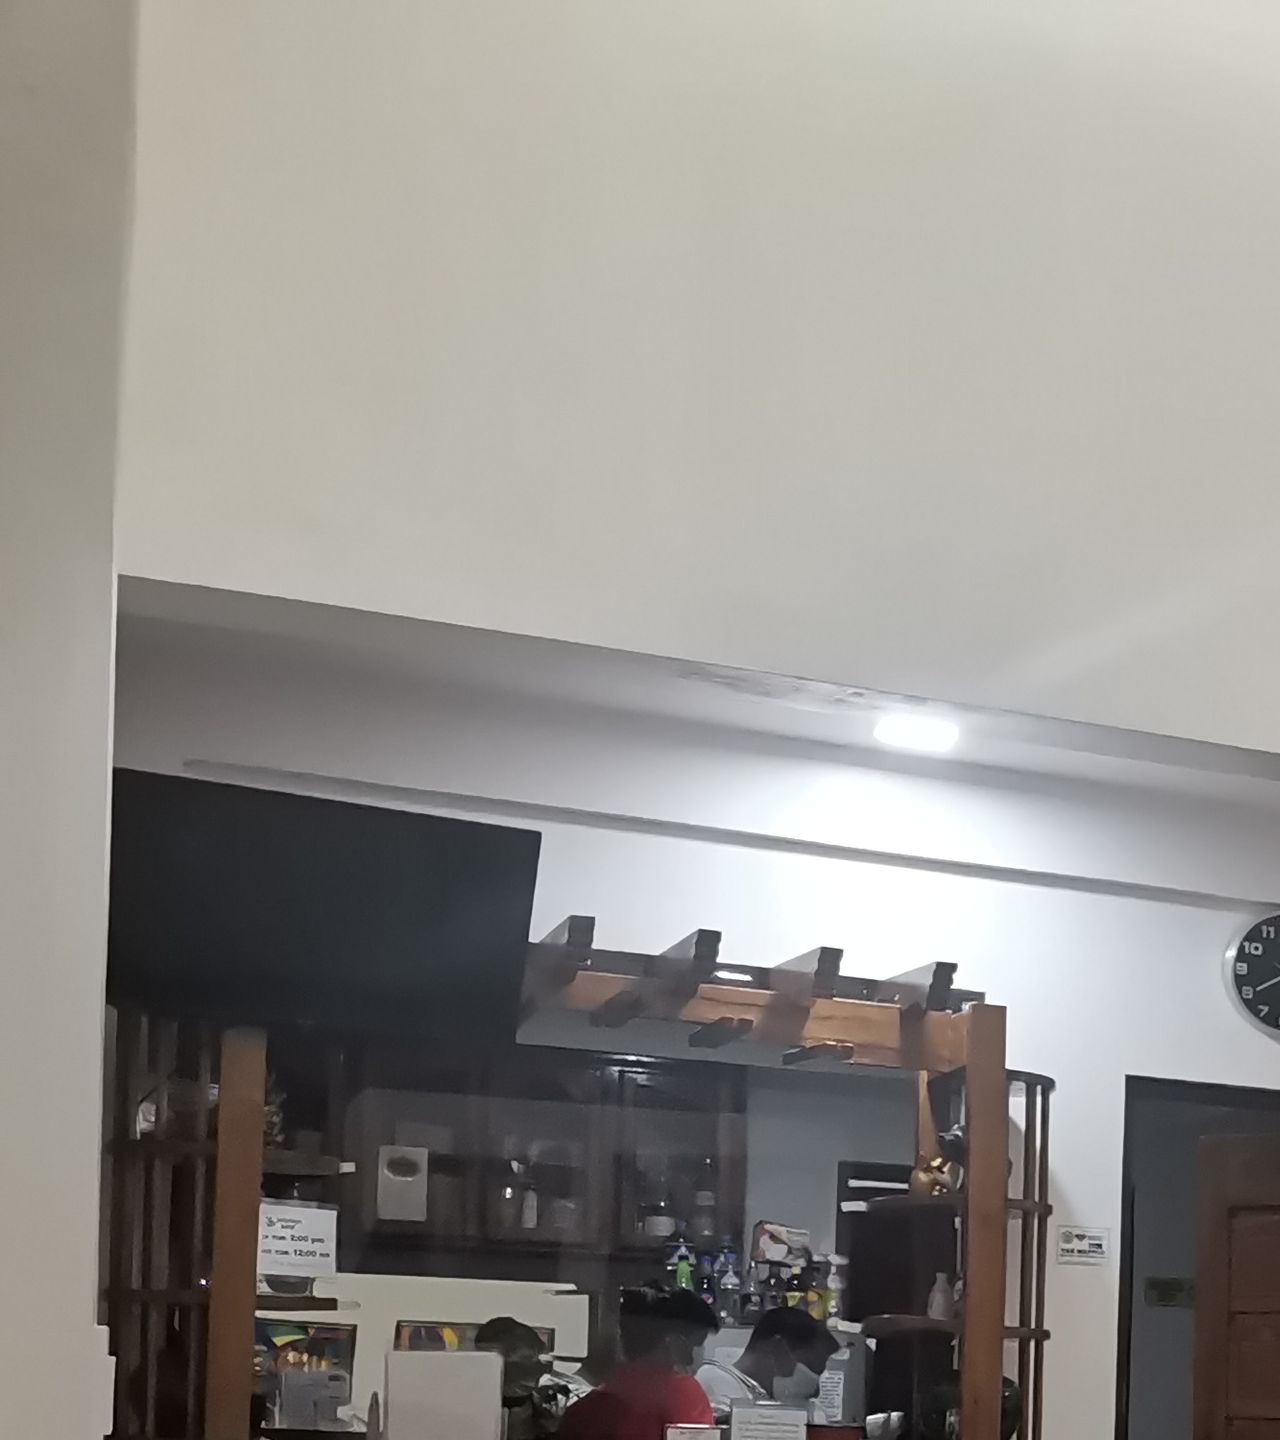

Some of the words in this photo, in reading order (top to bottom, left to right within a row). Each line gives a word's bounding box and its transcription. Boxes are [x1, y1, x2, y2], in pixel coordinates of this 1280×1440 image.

[1261, 925, 1275, 939] 11
[1242, 941, 1263, 955] 10
[1235, 962, 1248, 975] 9
[1241, 985, 1254, 999] 8
[1257, 1004, 1270, 1017] 7
[293, 1249, 317, 1257] 12:00
